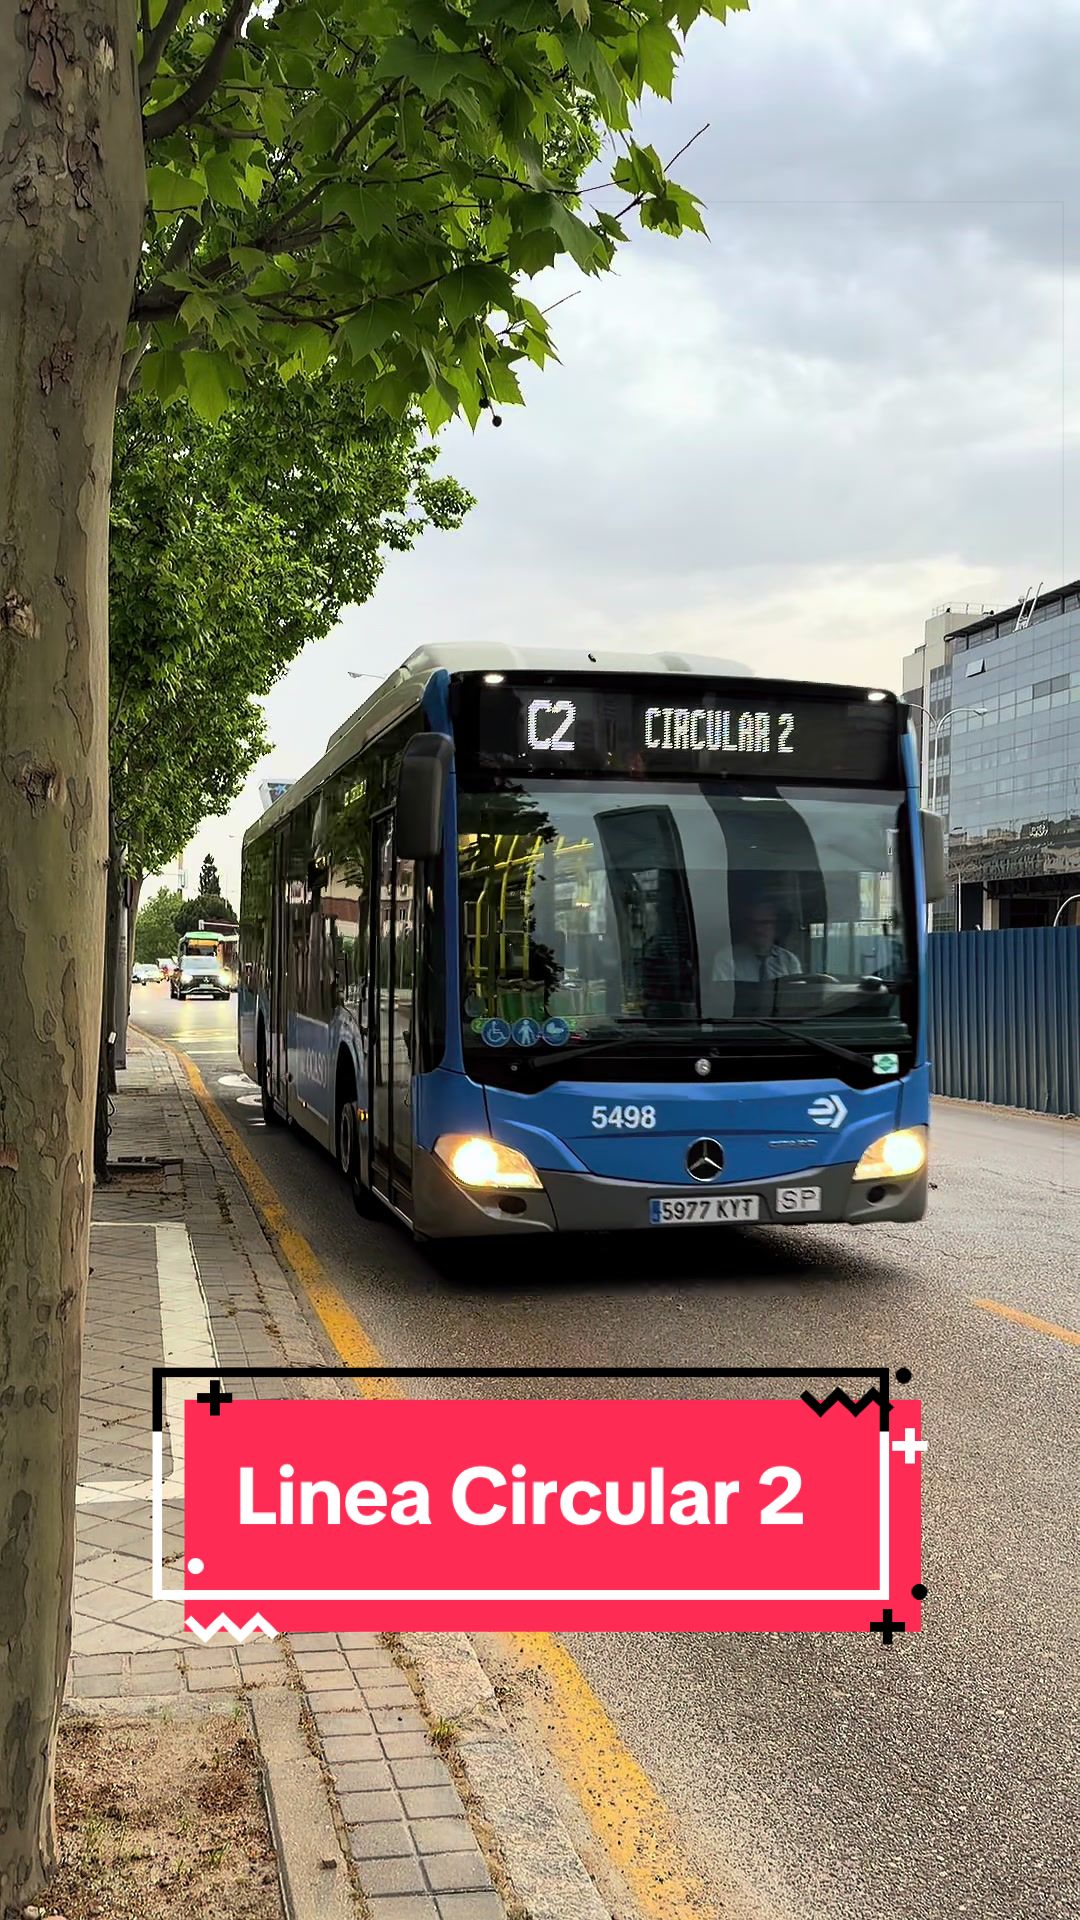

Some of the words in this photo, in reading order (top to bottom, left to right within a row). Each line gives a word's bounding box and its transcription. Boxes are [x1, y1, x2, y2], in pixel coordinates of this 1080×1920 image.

[528, 700, 576, 750] C2
[645, 707, 770, 752] CIRCULAR
[778, 713, 794, 753] 2
[591, 1105, 656, 1129] 5498
[662, 1201, 710, 1221] 5977
[717, 1199, 753, 1219] KYT
[782, 1189, 816, 1210] SP
